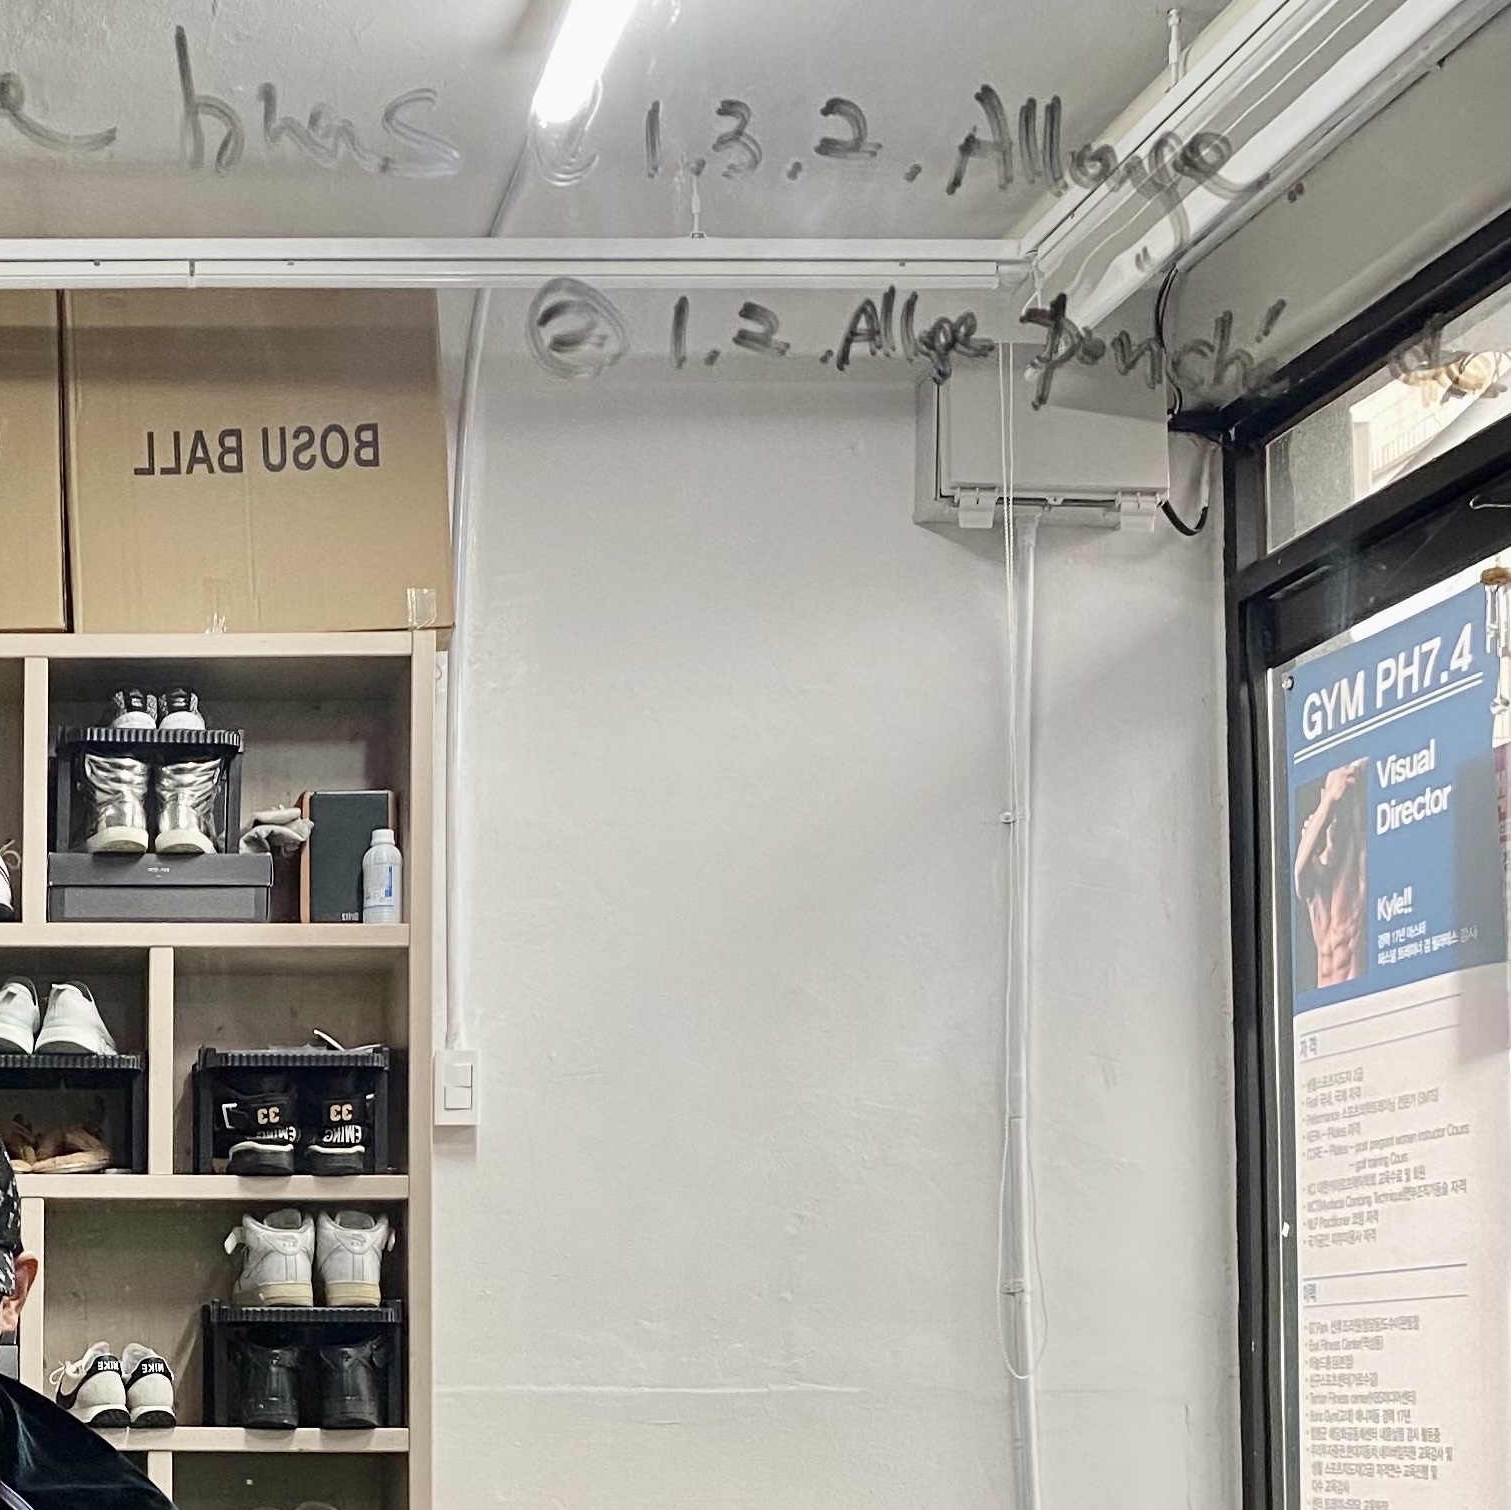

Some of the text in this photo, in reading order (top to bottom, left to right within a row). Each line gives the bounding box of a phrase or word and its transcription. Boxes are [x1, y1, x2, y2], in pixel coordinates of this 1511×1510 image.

[1302, 622, 1473, 740] GYM PH7.4
[1376, 738, 1436, 789] Visual
[1376, 783, 1453, 835] Director
